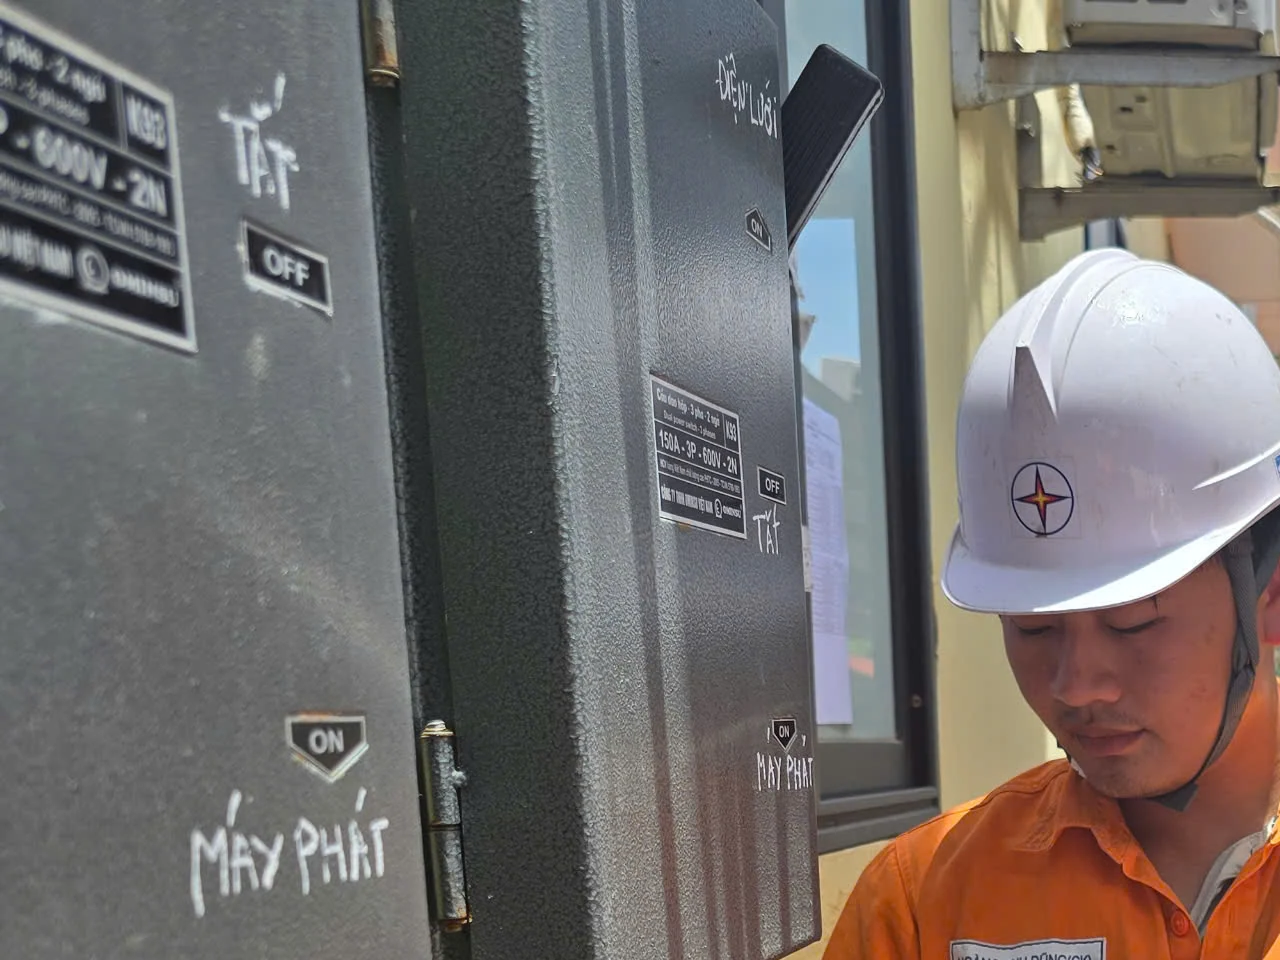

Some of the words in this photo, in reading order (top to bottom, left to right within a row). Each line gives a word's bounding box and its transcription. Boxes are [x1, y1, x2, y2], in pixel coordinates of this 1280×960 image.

[751, 218, 763, 239] ON
[262, 247, 310, 286] OFF
[658, 428, 680, 454] 150A
[685, 439, 696, 460] 3P
[702, 446, 721, 469] 600V
[726, 456, 737, 475] 2N
[765, 478, 779, 494] OFF
[309, 729, 344, 754] ON
[779, 726, 789, 738] ON
[190, 788, 284, 918] MÁY
[293, 786, 389, 896] PHÁT
